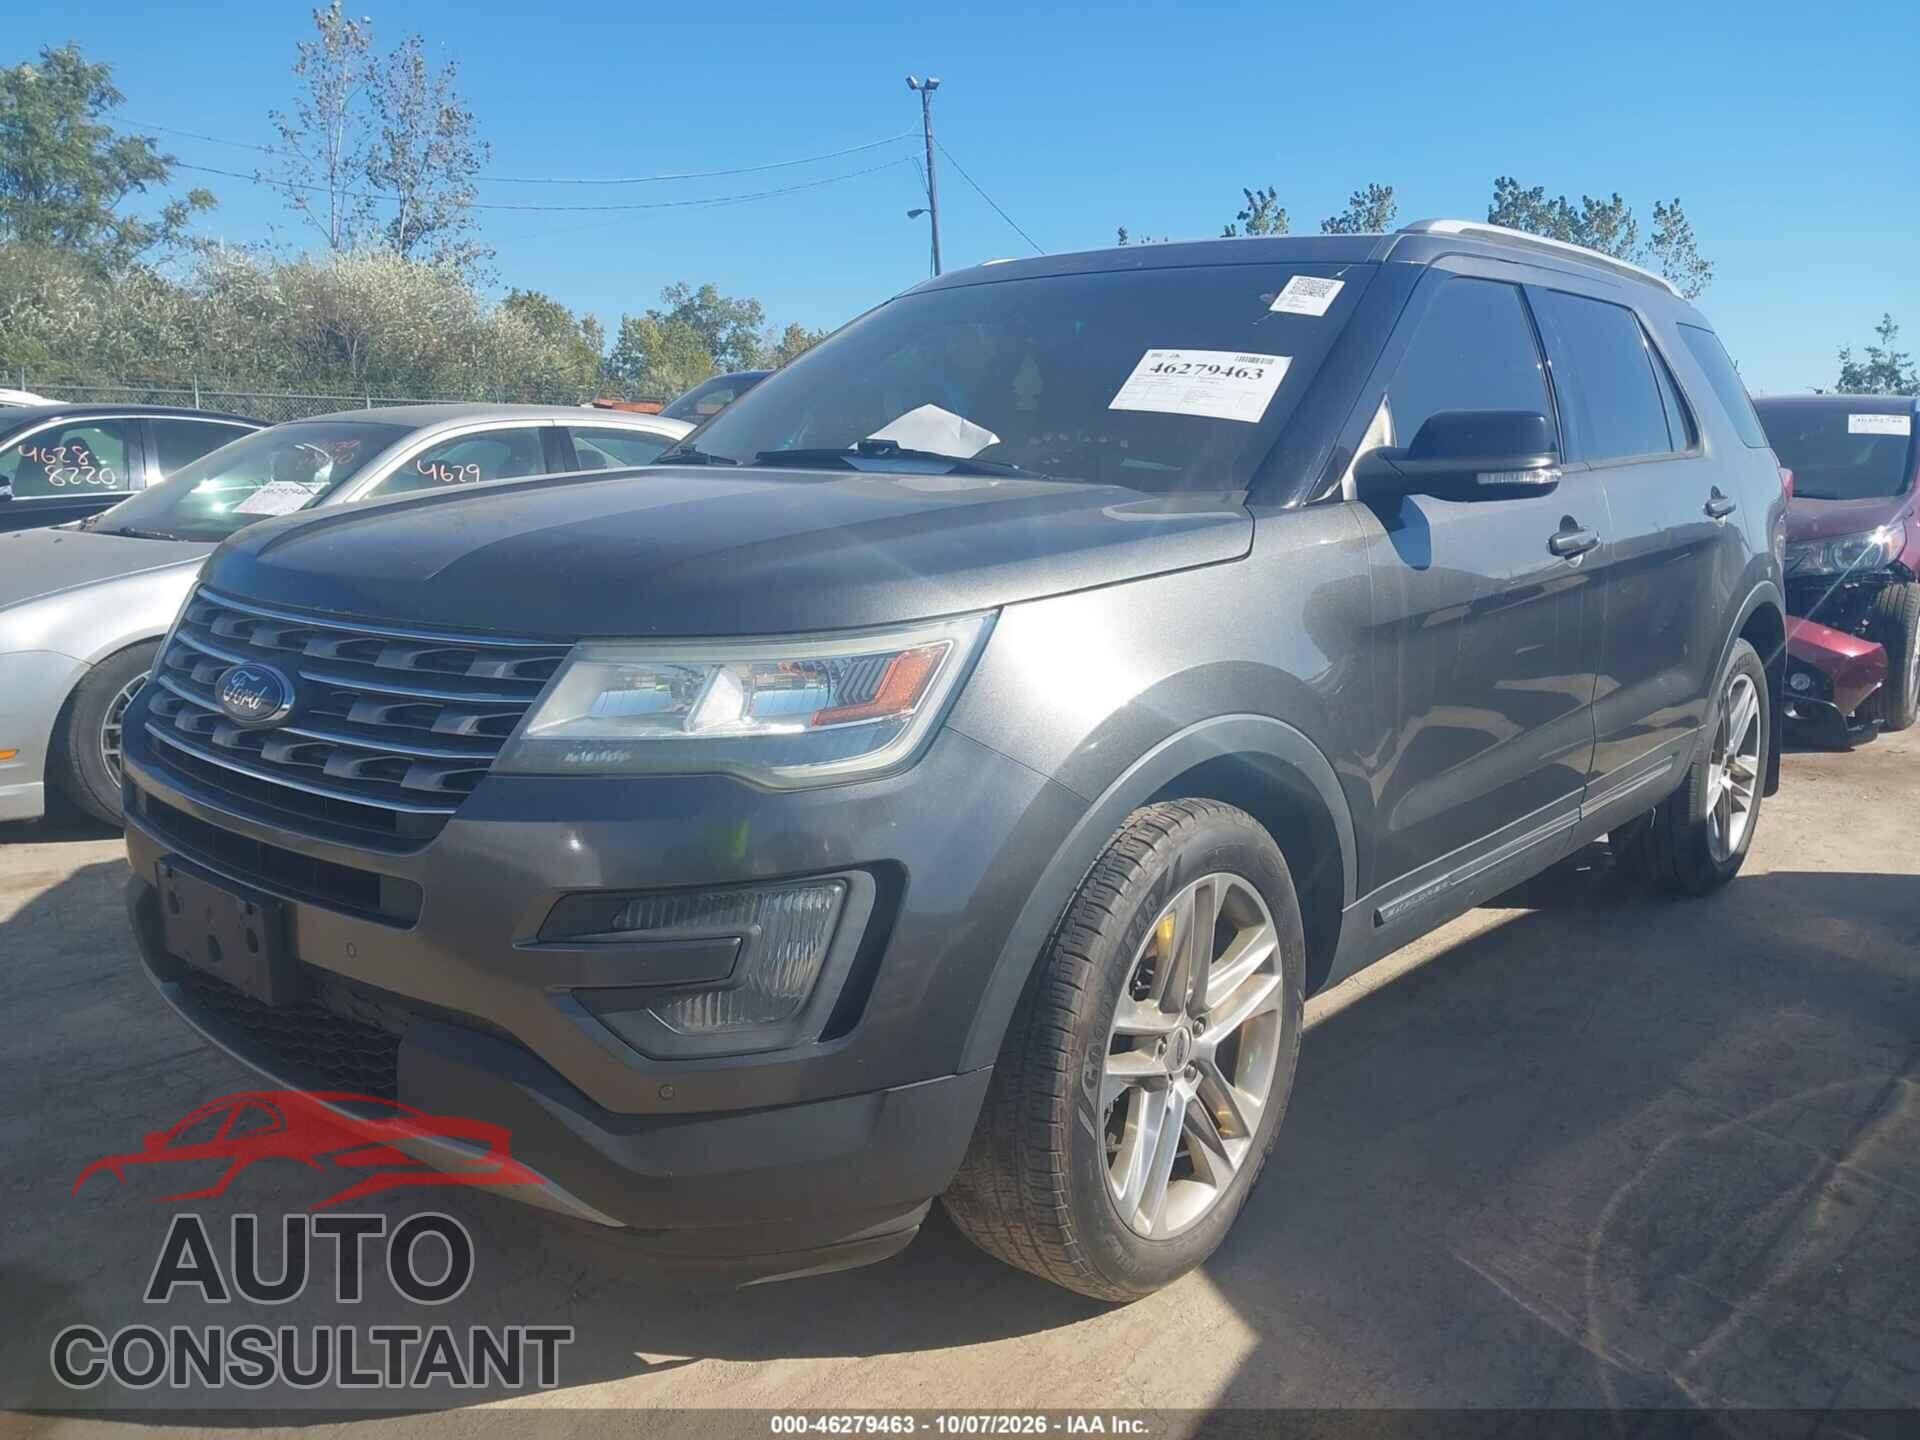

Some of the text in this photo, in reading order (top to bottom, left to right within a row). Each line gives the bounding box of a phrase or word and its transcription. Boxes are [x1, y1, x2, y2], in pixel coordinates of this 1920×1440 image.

[1149, 361, 1265, 380] 46279463
[18, 445, 90, 465] 4628
[44, 464, 116, 486] 8220
[416, 459, 480, 483] 4629
[223, 670, 269, 710] Ford
